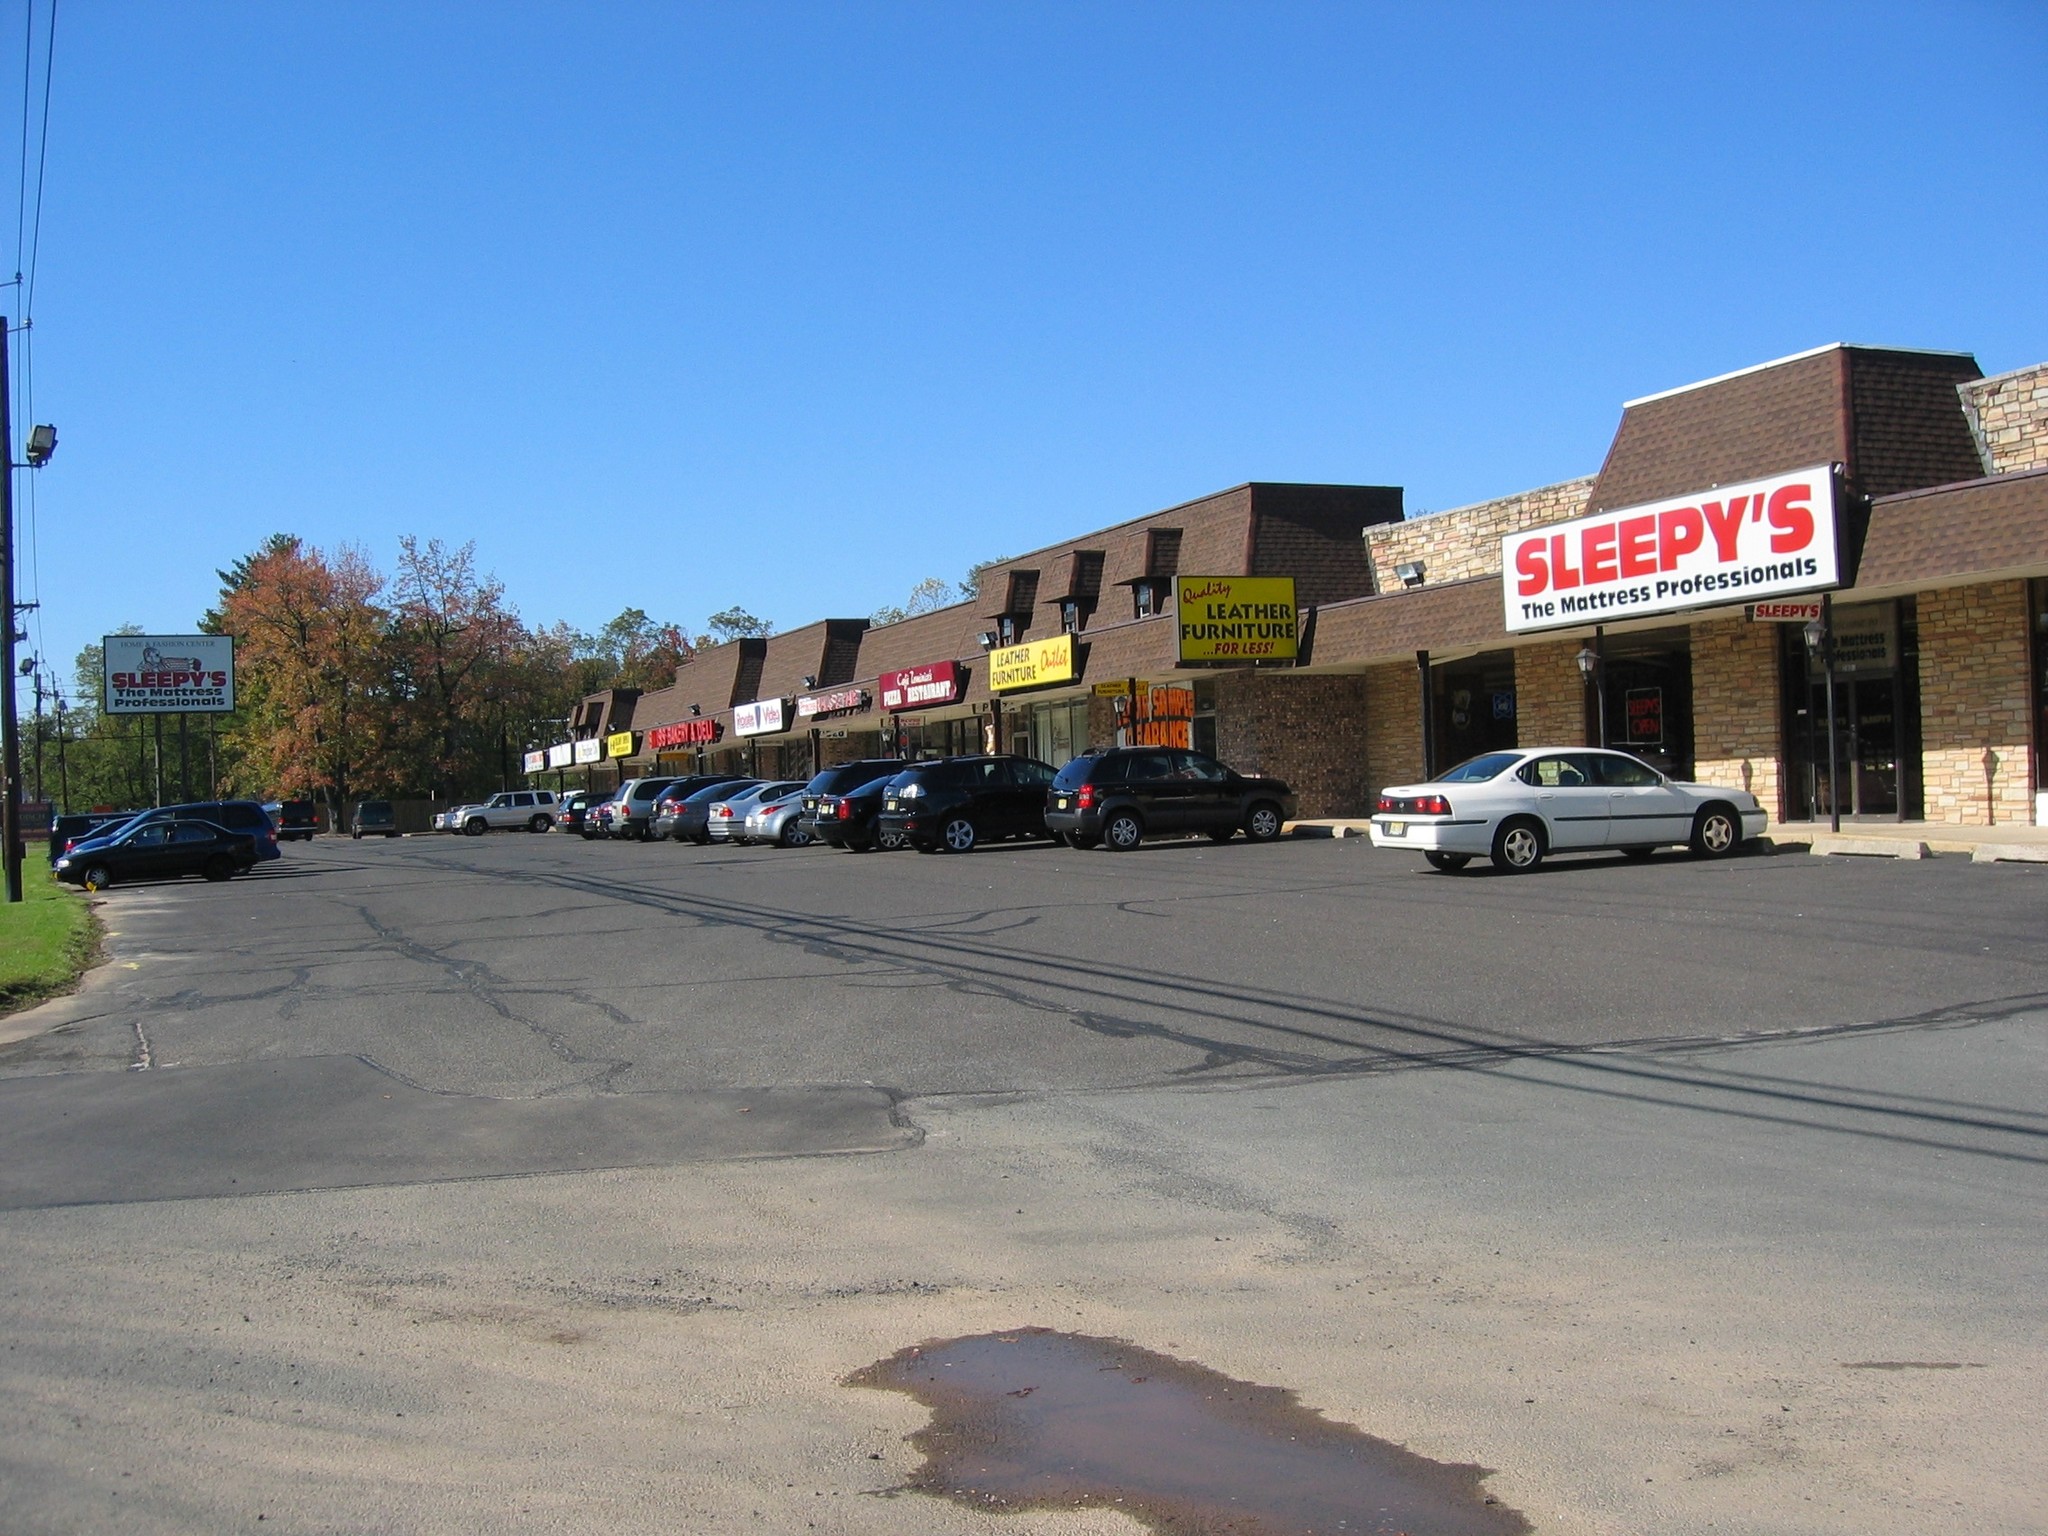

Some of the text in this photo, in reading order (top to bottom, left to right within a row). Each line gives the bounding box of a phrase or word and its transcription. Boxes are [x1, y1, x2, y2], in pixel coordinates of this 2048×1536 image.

[1516, 484, 1815, 596] SLEEPY'S
[1183, 581, 1232, 604] Quality
[1522, 557, 1818, 620] The Mattress Professionals
[1207, 603, 1291, 620] LEATHER
[1756, 604, 1819, 618] SLEEPY'S
[1182, 623, 1294, 640] FURNITURE
[996, 648, 1030, 668] LEATHER
[1040, 644, 1069, 672] Outlet
[1243, 642, 1275, 654] LESS!
[112, 671, 227, 688] SLEEPY'S
[992, 665, 1036, 686] FURNITURE
[116, 688, 223, 697] The Mattress
[907, 680, 951, 703] RESTAURANT
[114, 697, 225, 707] Professionals
[1152, 687, 1195, 718] SAMPLE
[1125, 720, 1189, 749] CEARANCE
